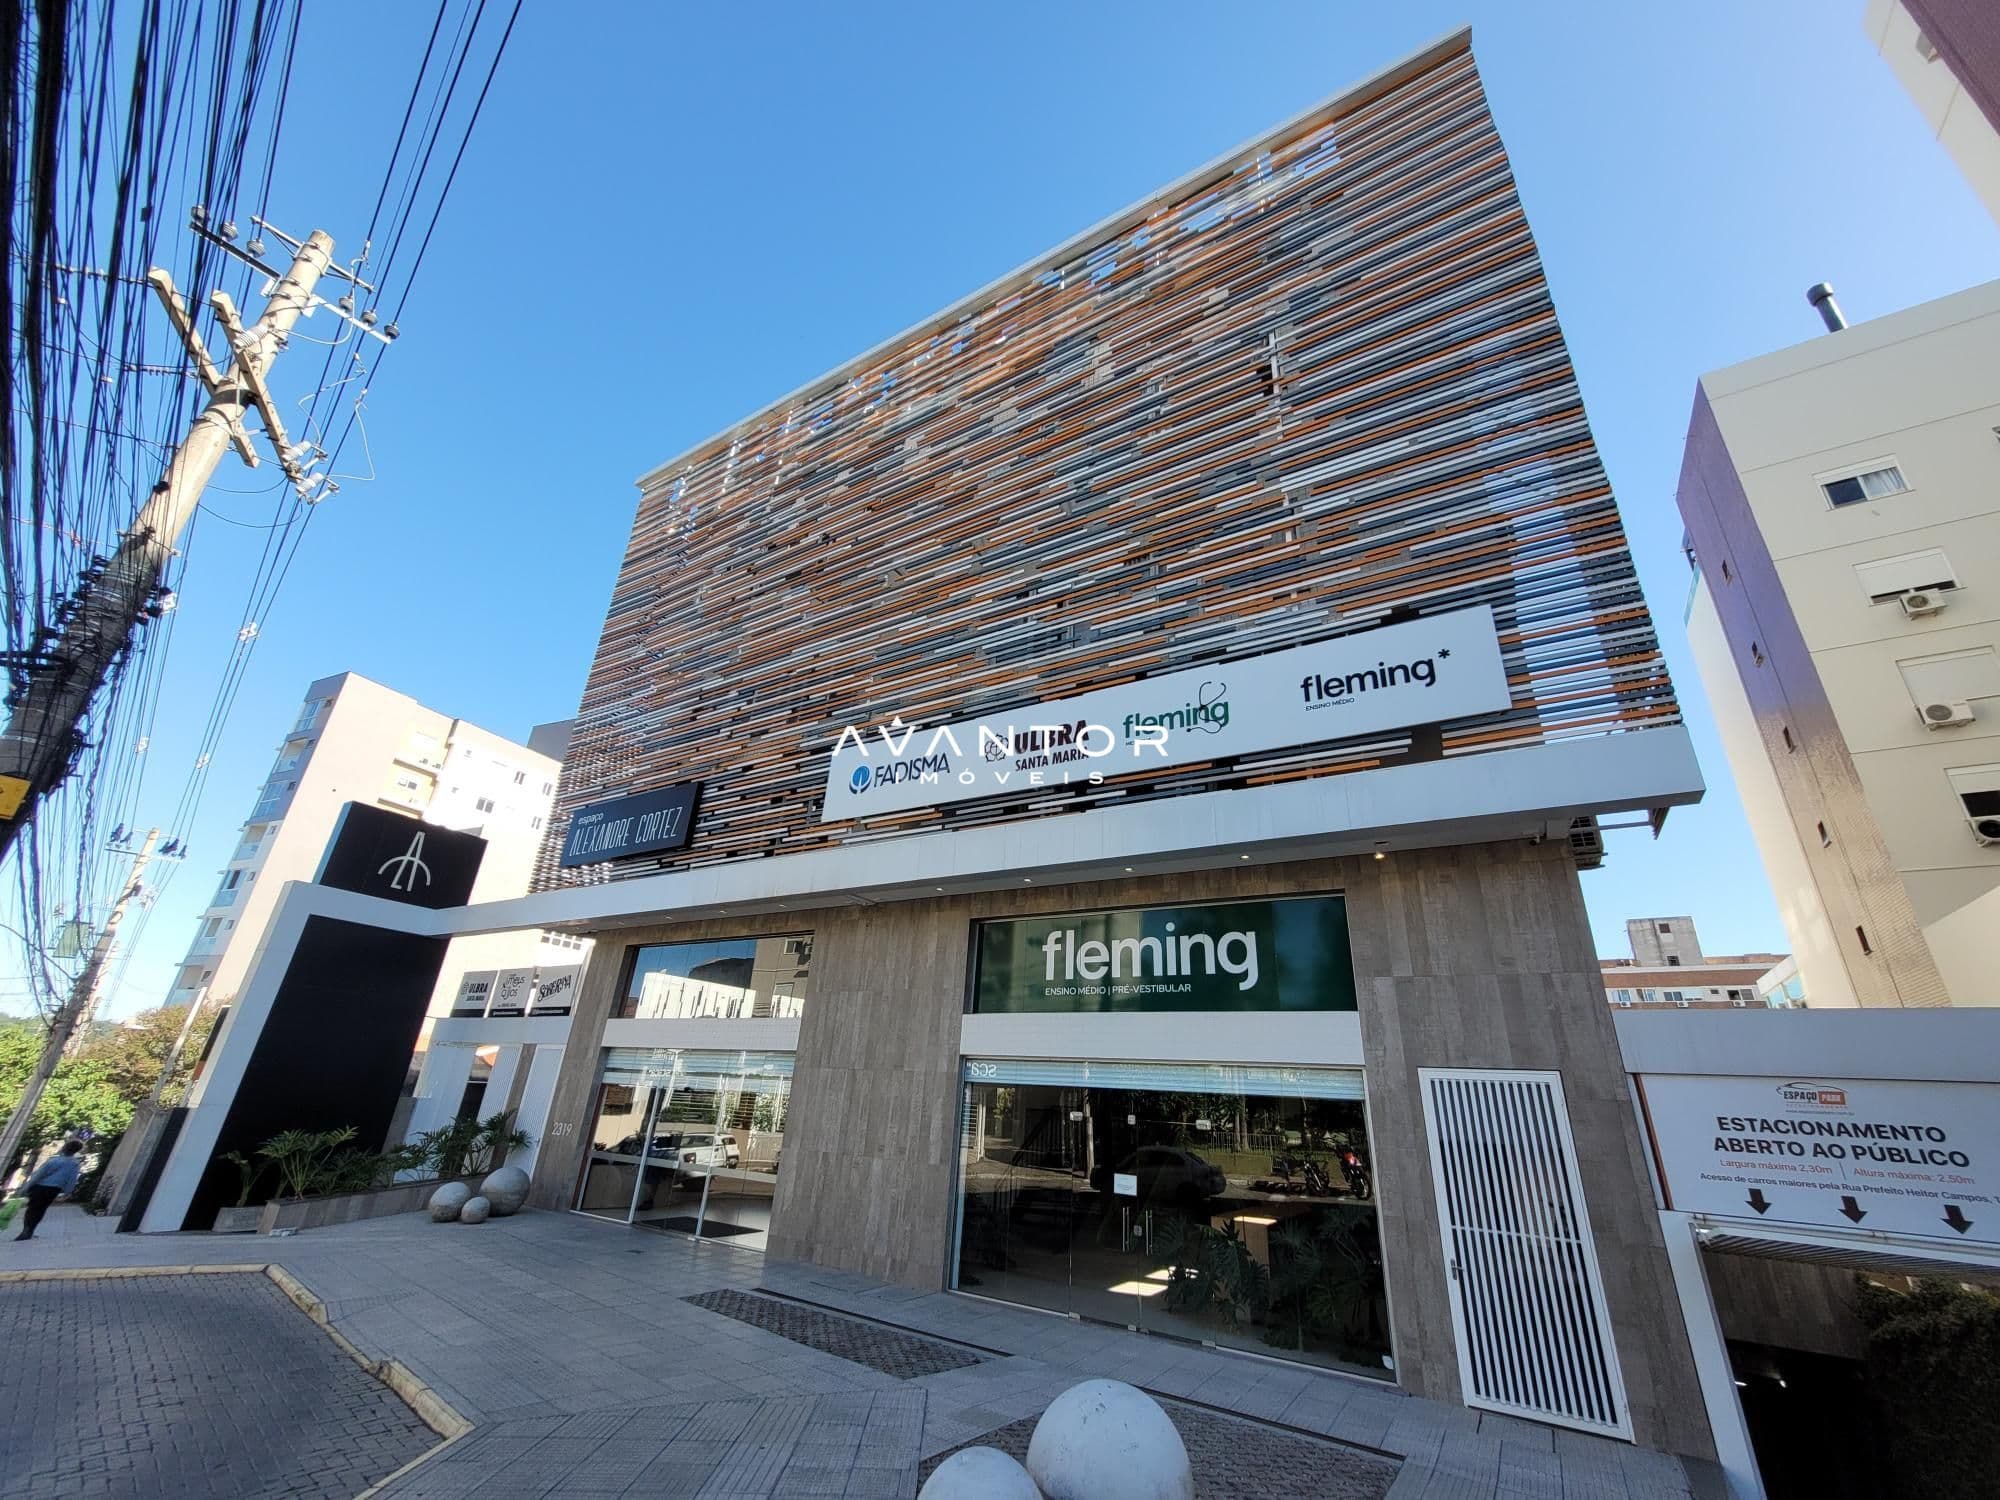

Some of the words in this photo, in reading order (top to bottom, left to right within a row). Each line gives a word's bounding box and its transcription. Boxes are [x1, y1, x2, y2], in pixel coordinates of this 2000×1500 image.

[1122, 699, 1230, 739] fleming
[1305, 703, 1331, 711] ENSINO
[1014, 719, 1090, 755] ULBRA
[873, 752, 951, 788] FADISMA
[1015, 755, 1049, 771] SANTA
[1052, 747, 1090, 765] MARIA
[569, 816, 635, 857] ALEXANDRE
[635, 806, 684, 844] CORTEZ
[578, 812, 605, 826] espaço
[1042, 921, 1260, 991] fleming
[1045, 986, 1077, 996] ENSINO
[1077, 984, 1106, 995] MÉDIO
[1112, 983, 1192, 994] PRÉ-VESTIBULAR
[1783, 1090, 1818, 1103] ESPAÇO
[551, 1121, 573, 1137] 2319
[1716, 1116, 1947, 1143] ESTACIONAMENTO
[1713, 1136, 1805, 1157] ABERTO
[1812, 1143, 1847, 1160] AO
[1851, 1142, 1970, 1168] PÚBLICO
[1720, 1159, 1757, 1169] Largura
[1758, 1162, 1798, 1172] máxima
[1798, 1164, 1833, 1174] 2,30m
[1853, 1167, 1886, 1178] Altura
[1700, 1172, 1732, 1182] Acesso
[1734, 1175, 1747, 1183] de
[1748, 1177, 1778, 1186] carros
[1779, 1180, 1818, 1189] maiores
[1819, 1182, 1841, 1191] pela
[1841, 1183, 1862, 1193] Rua
[1862, 1184, 1905, 1196] Prefeito
[1905, 1188, 1939, 1199] Heitor
